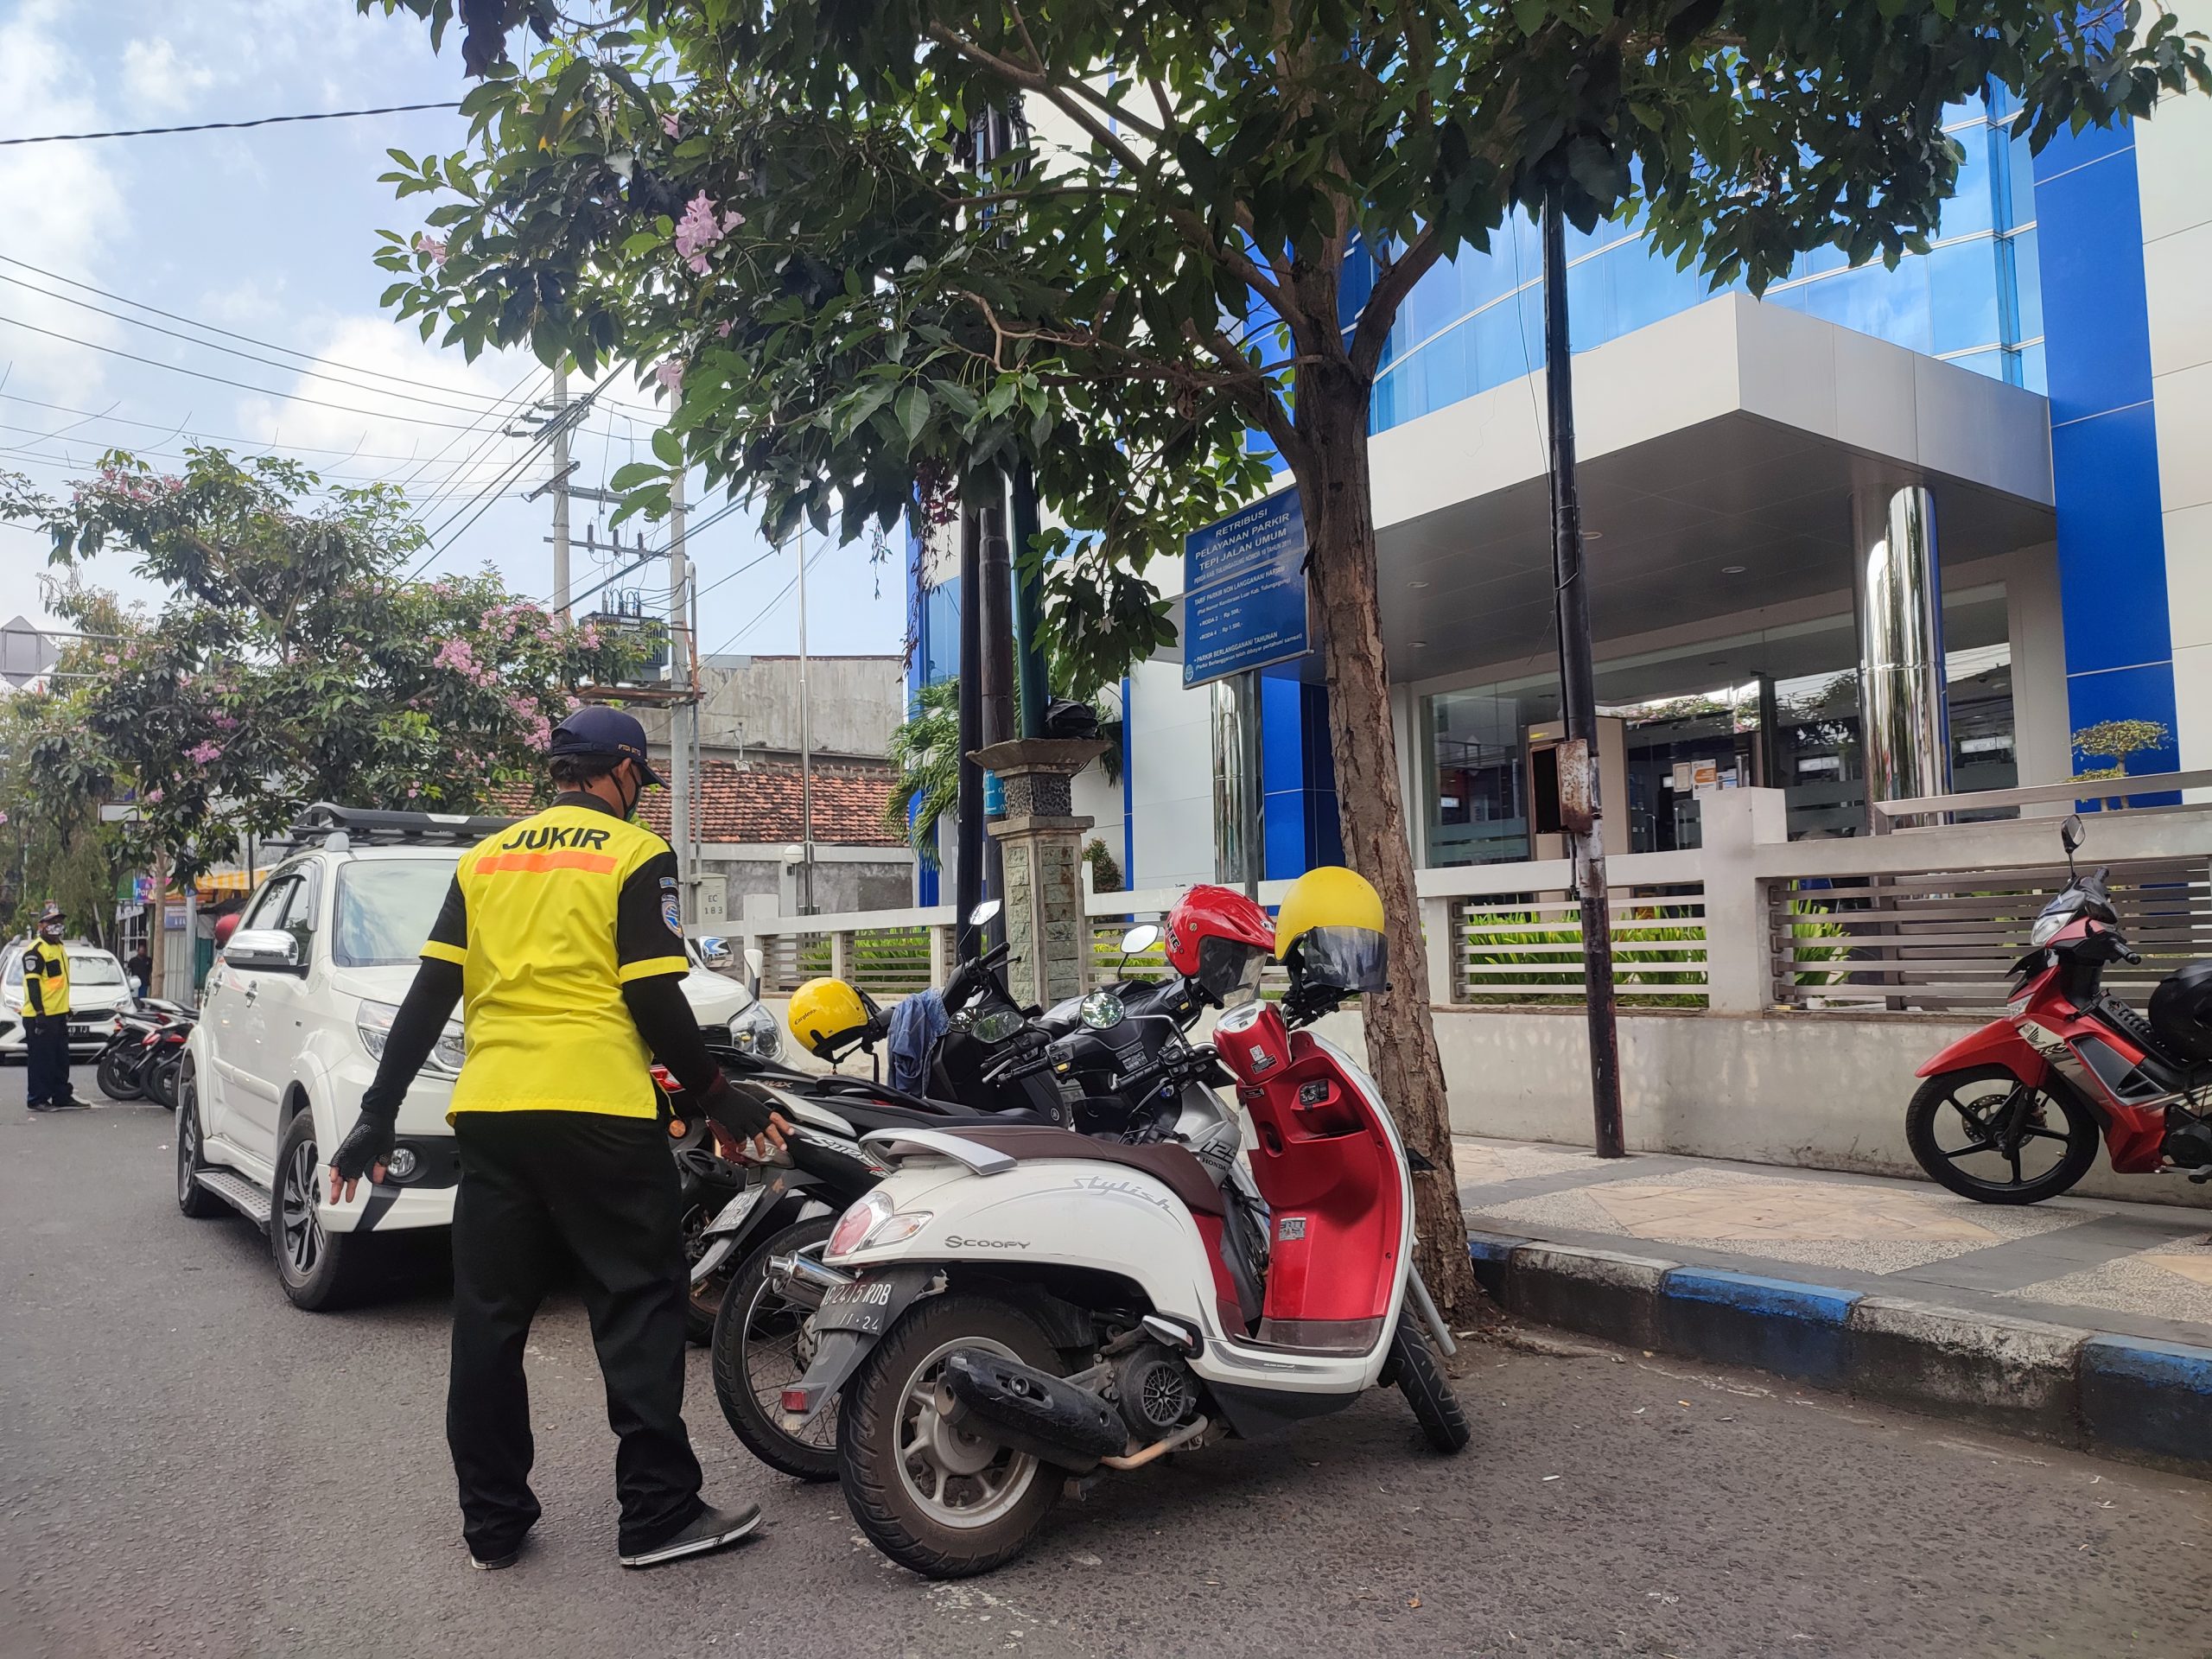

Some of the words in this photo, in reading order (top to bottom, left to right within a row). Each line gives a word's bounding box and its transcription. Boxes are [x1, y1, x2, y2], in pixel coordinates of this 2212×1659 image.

[1195, 531, 1249, 560] PELAYANAN
[1251, 513, 1289, 535] PARKIR
[1216, 508, 1267, 538] RETRIBUSI
[1199, 556, 1217, 571] TEPI
[1220, 543, 1251, 562] JALAN
[1255, 528, 1286, 547] UMUM
[1216, 557, 1244, 575] TULUNGAGUNG
[1245, 551, 1260, 561] NOMOR
[1267, 543, 1281, 552] TAHUN
[1194, 596, 1205, 606] TARIF
[1206, 589, 1222, 601] PARKIR
[1223, 585, 1233, 594] NON
[1265, 565, 1285, 577] HARIAN
[1219, 594, 1240, 607] Kendaraan
[1195, 662, 1208, 671] (Parkir
[1208, 654, 1235, 668] Berlangganan
[1247, 646, 1262, 655] dibayar
[1284, 633, 1302, 644] samsat)
[1197, 652, 1212, 663] PARKIR
[1254, 632, 1277, 643] TAHUNAN
[502, 827, 611, 850] JUKIR
[704, 906, 723, 915] 183
[708, 894, 718, 903] EC
[1202, 1157, 1227, 1172] HONDA
[1072, 1175, 1171, 1211] Stylish
[831, 1283, 867, 1305] 2415
[861, 1283, 892, 1306] RDB
